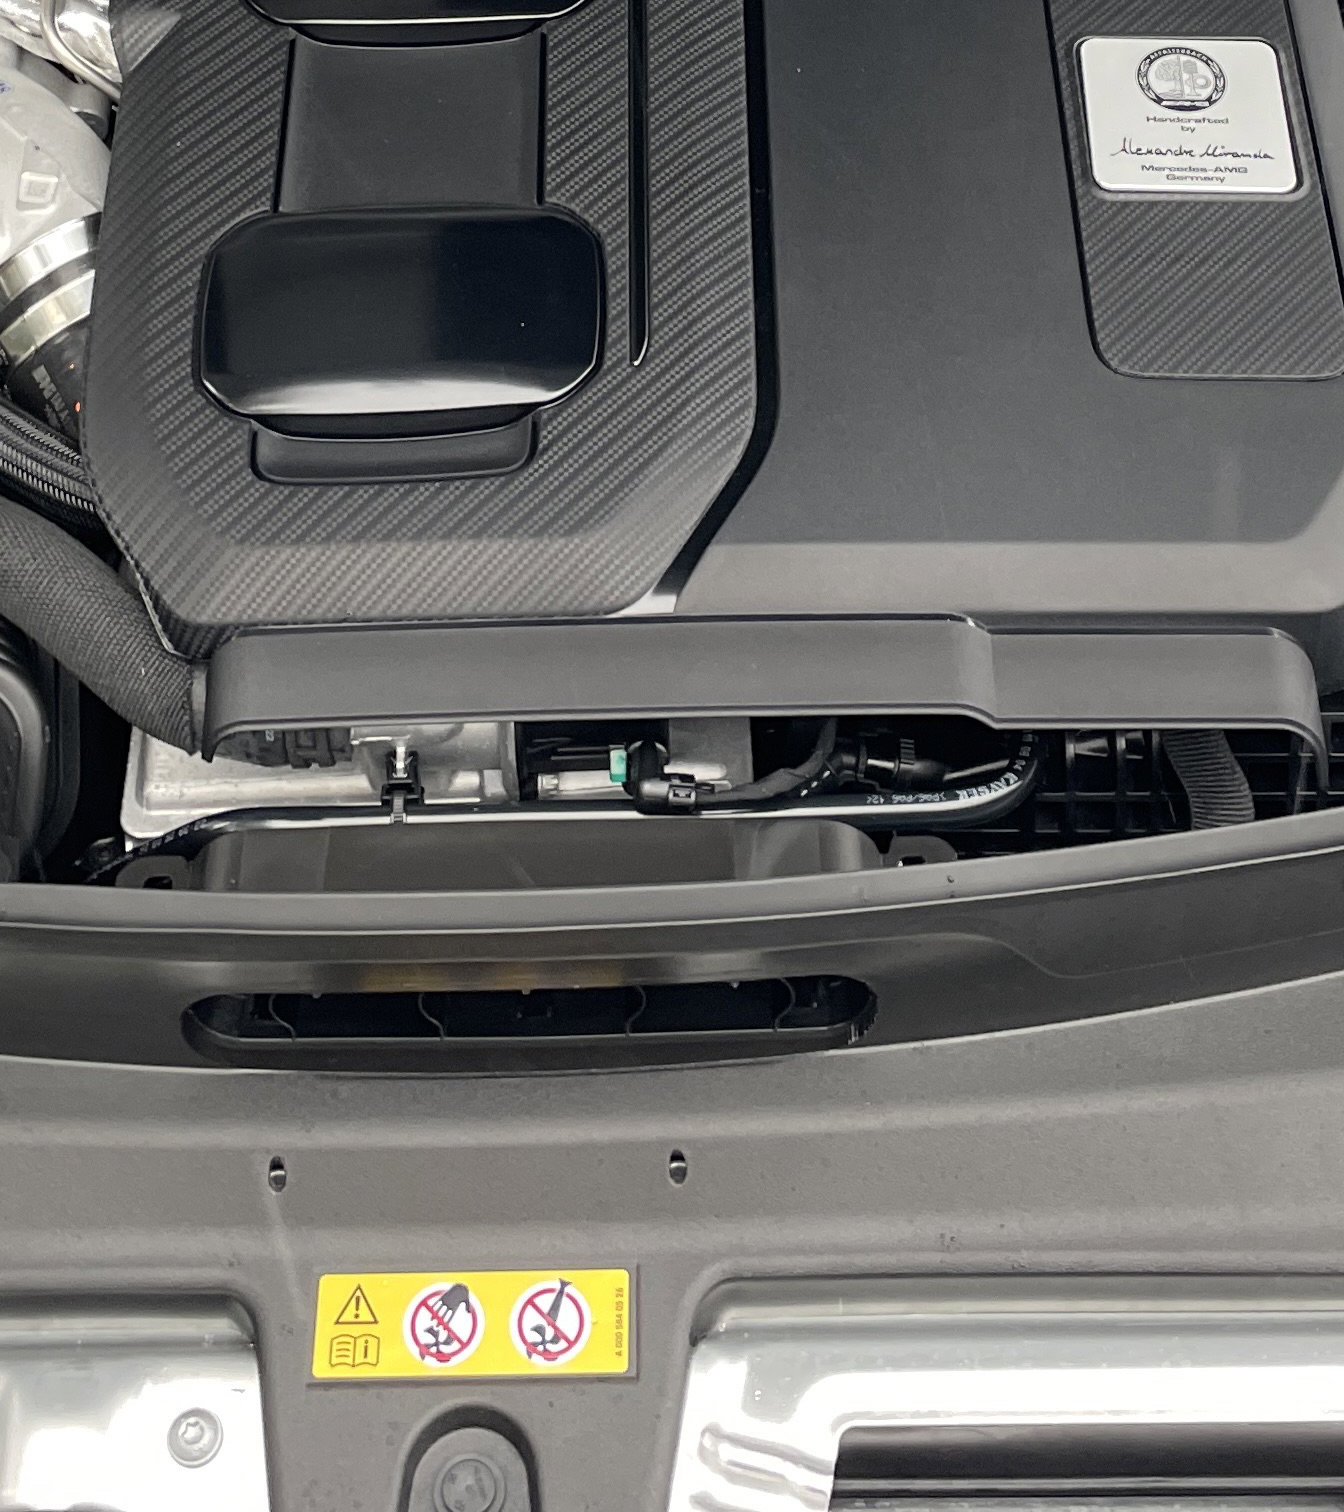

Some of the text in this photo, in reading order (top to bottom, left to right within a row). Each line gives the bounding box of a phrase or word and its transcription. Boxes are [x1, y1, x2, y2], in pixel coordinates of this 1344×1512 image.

[1146, 116, 1229, 124] Handcrafted
[1181, 125, 1196, 133] by
[1141, 164, 1248, 174] Mercedes-AMG
[1166, 174, 1226, 183] Germany
